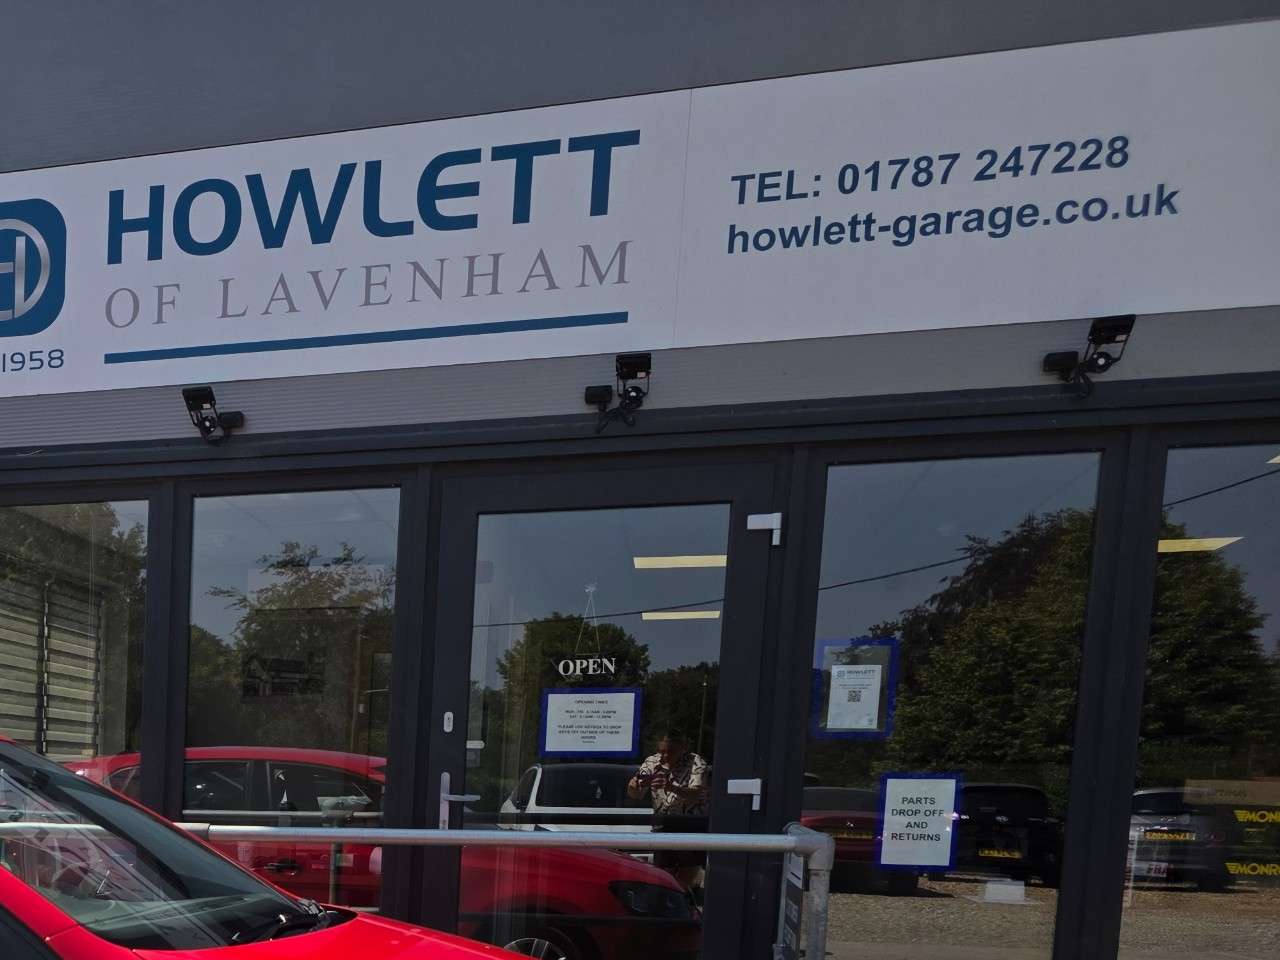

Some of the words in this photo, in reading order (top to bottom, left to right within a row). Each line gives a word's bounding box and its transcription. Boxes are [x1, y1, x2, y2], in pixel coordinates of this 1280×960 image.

[731, 170, 822, 205] TEL:
[838, 153, 961, 196] 01787
[974, 136, 1131, 183] 247228
[107, 130, 641, 266] HOWLETT
[727, 184, 1180, 255] howlett-garage.co.uk
[105, 283, 181, 329] OF
[220, 240, 632, 319] LAVENHAM
[2, 349, 65, 373] 1958
[558, 658, 617, 676] OPEN
[901, 796, 937, 805] PARTS
[891, 808, 921, 817] DROP
[923, 808, 945, 817] OFF
[905, 821, 928, 830] AND
[890, 832, 942, 843] RETURNS
